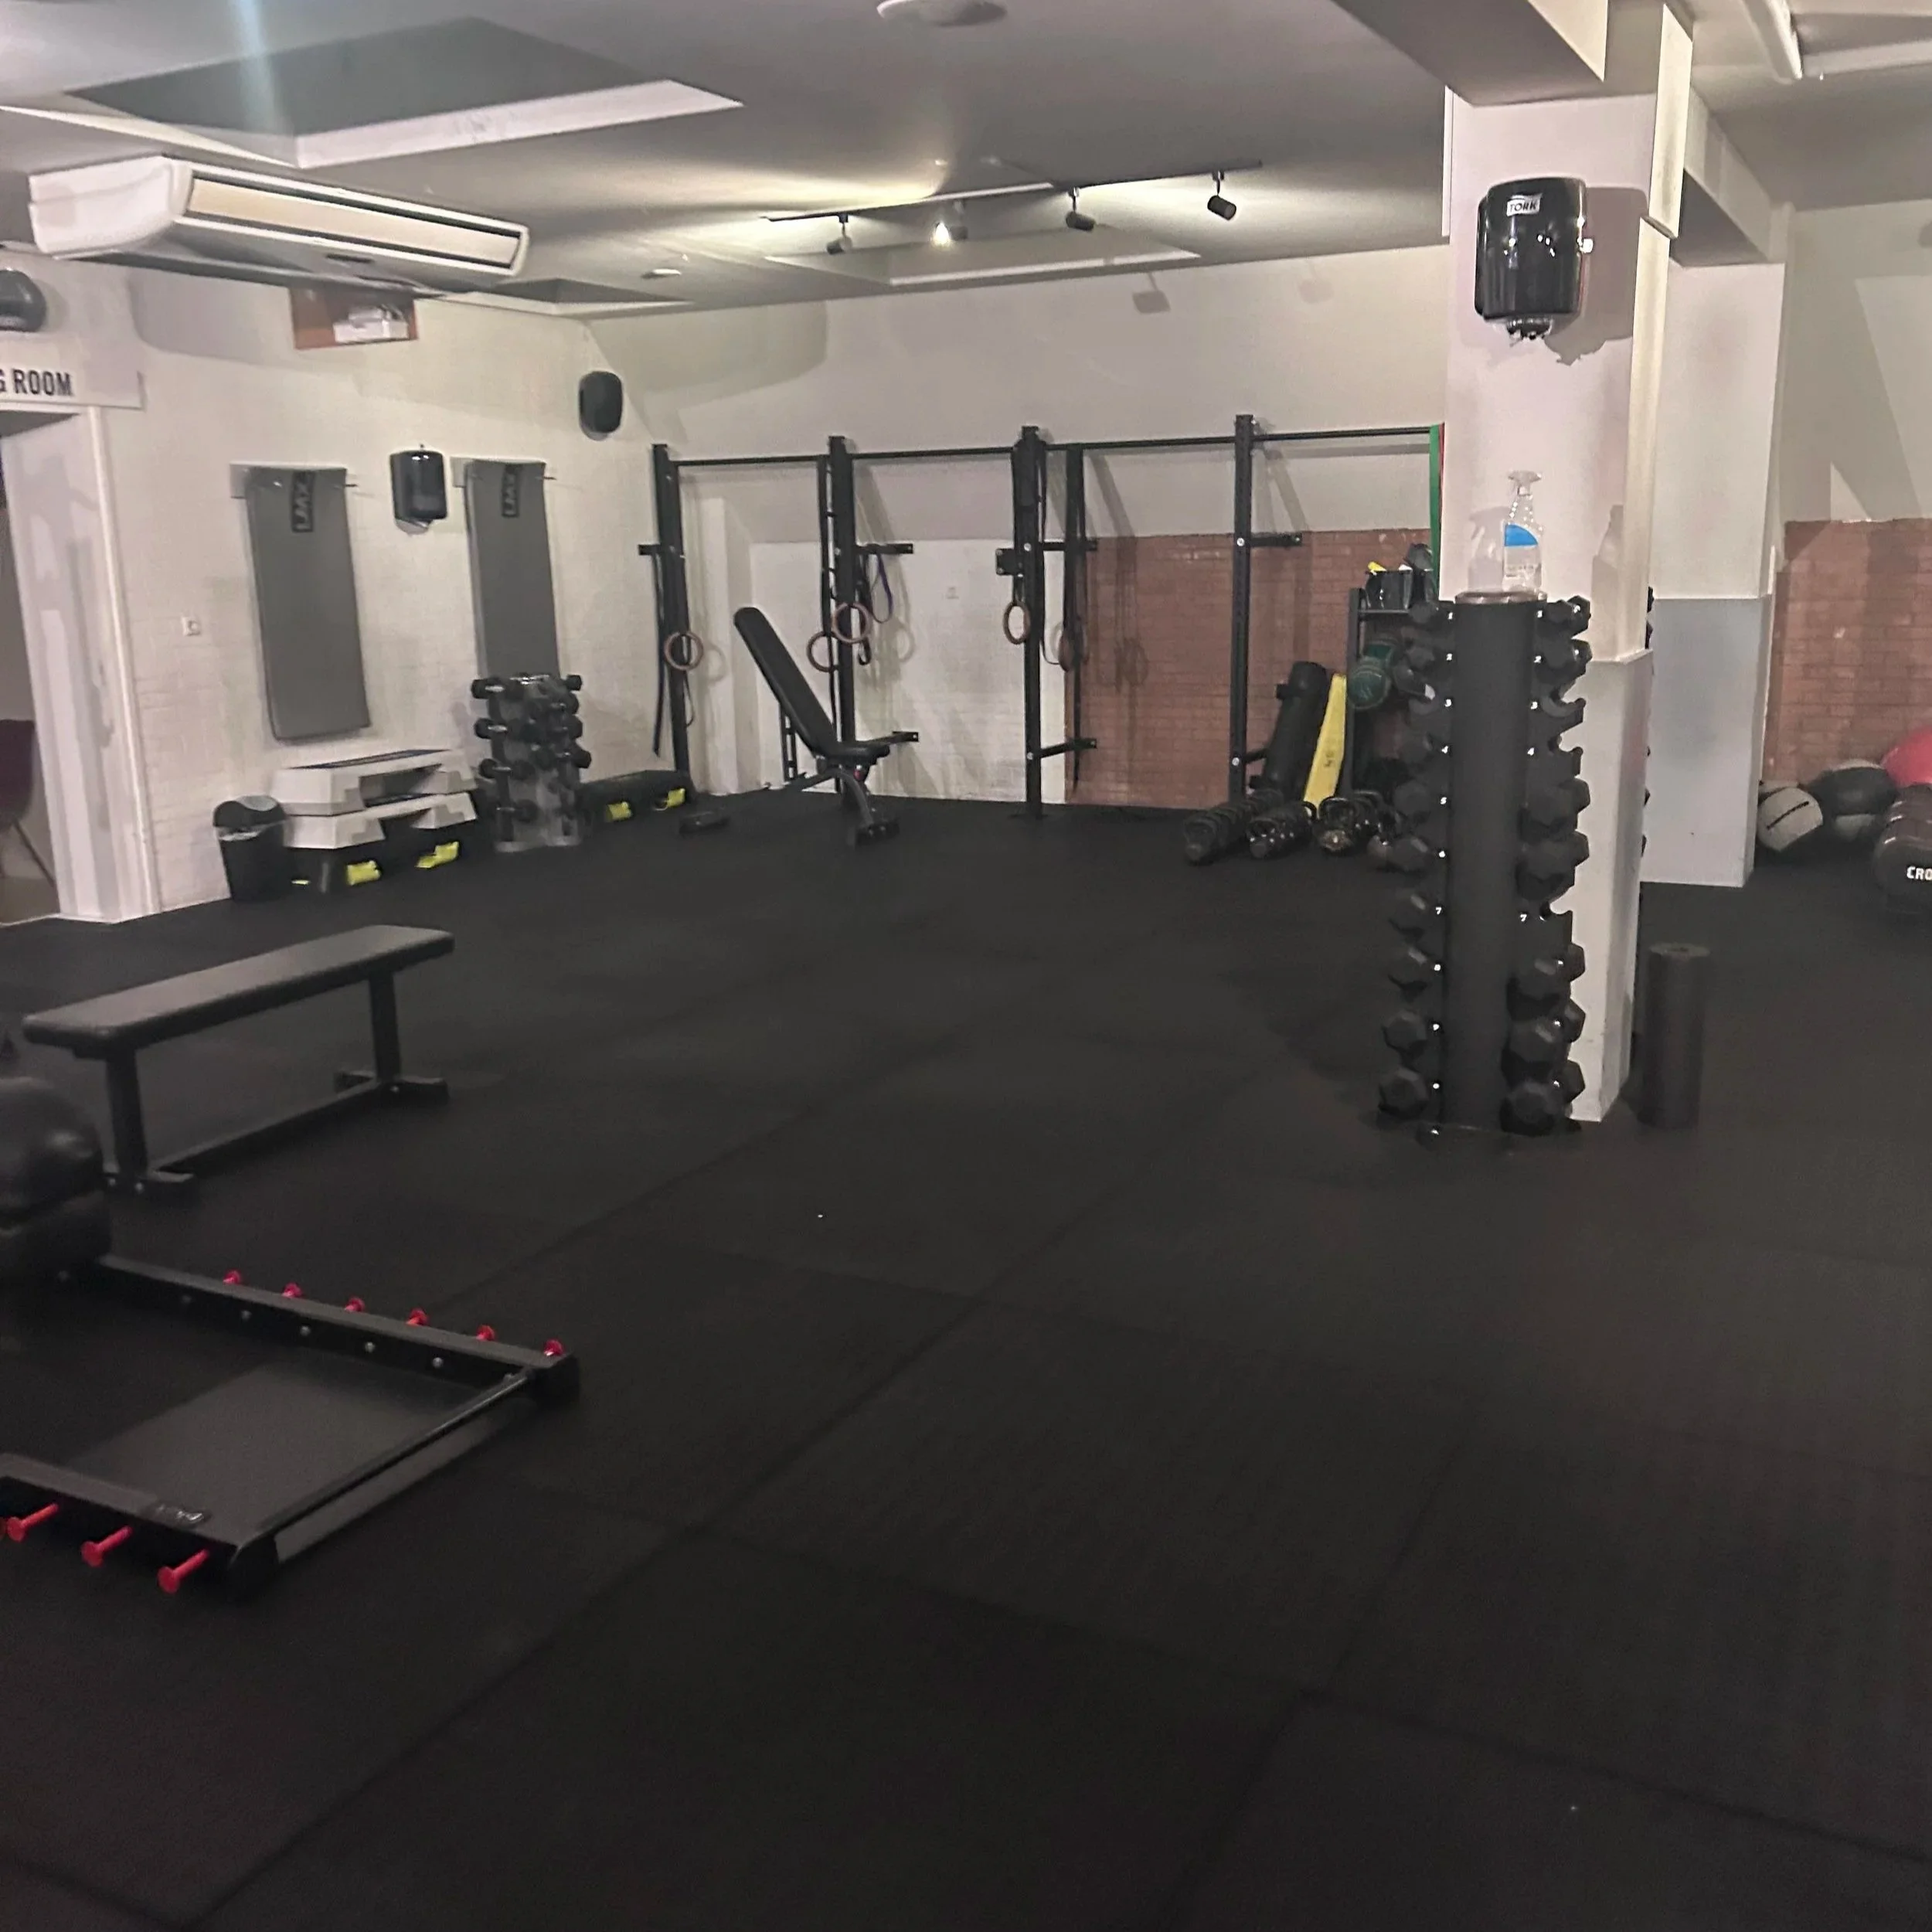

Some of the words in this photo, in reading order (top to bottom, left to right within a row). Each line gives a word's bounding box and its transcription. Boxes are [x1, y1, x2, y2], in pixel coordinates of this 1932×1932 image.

[1509, 202, 1536, 212] TORK
[12, 368, 73, 396] ROOM
[1906, 866, 1932, 880] CRO
